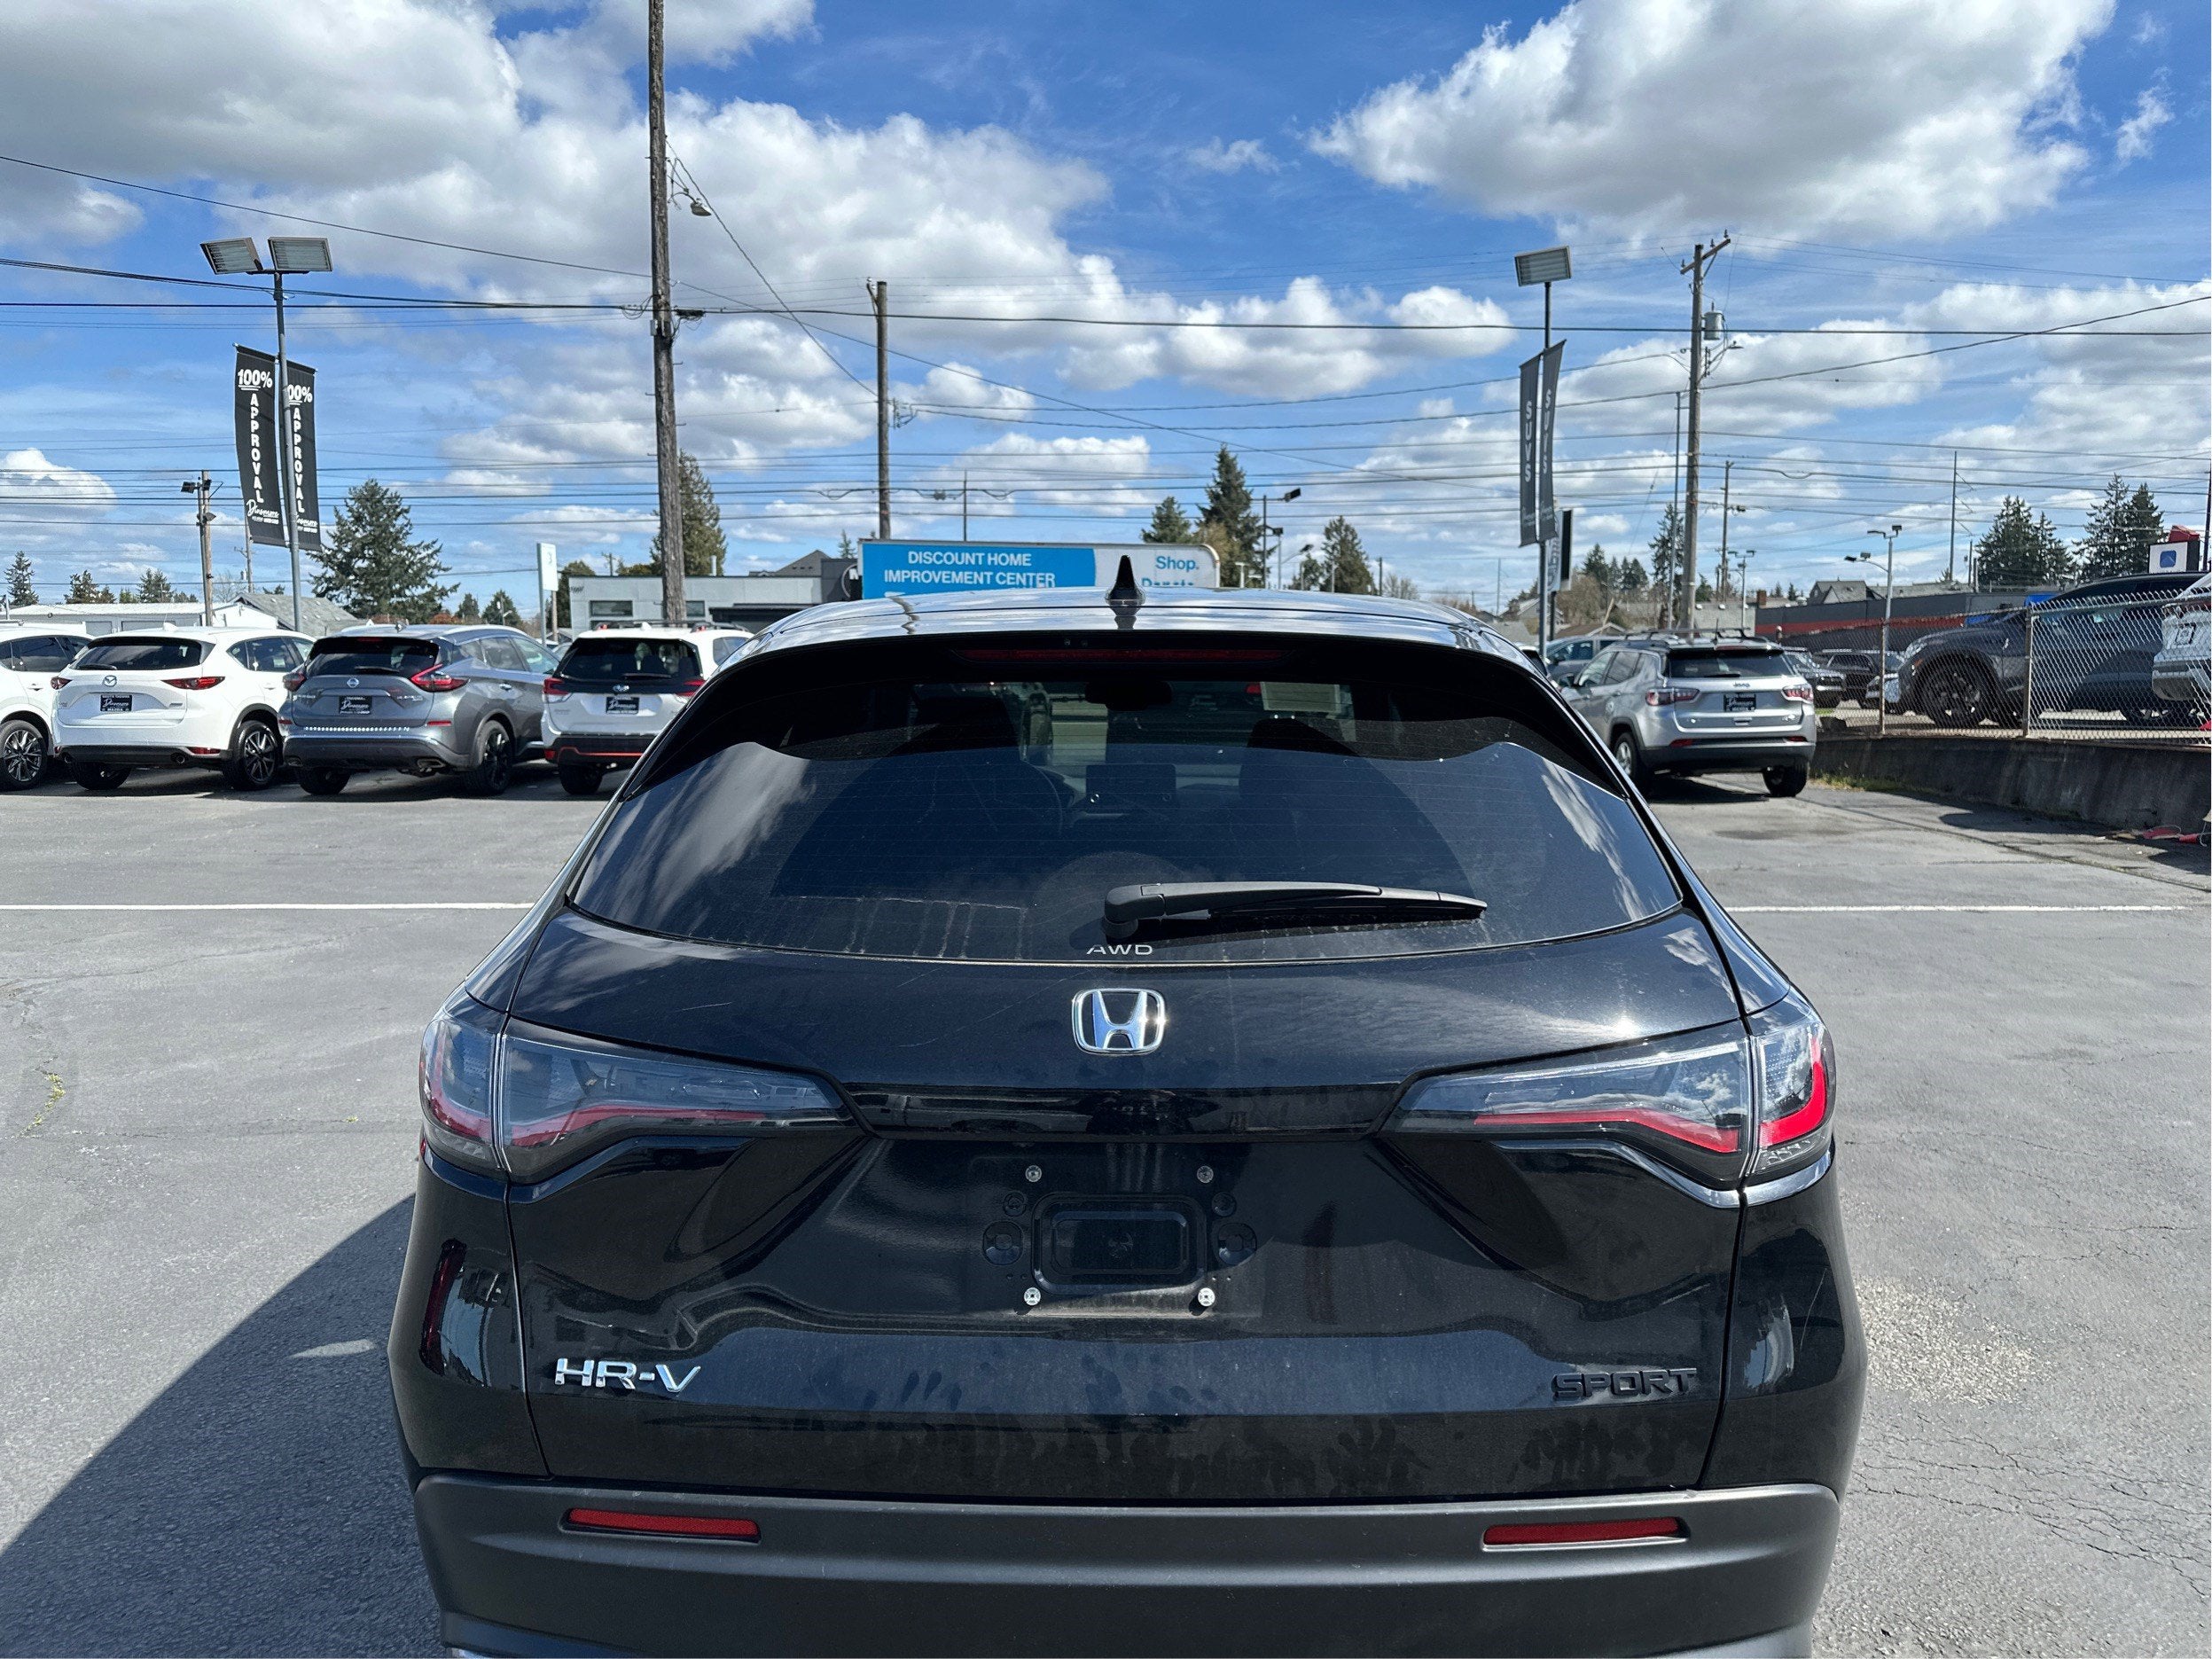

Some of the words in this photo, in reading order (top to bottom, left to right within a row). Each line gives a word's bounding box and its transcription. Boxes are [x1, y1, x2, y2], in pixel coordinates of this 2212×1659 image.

[238, 369, 273, 388] 100%
[287, 384, 313, 403] 00%
[250, 393, 264, 504] APPROVAL
[293, 407, 305, 513] APPROVAL
[908, 551, 986, 565] DISCOUNT
[988, 552, 1032, 567] HOME
[1155, 556, 1200, 573] Shop.
[884, 569, 994, 585] IMPROVEMENT
[996, 571, 1056, 588] CENTER
[1086, 944, 1153, 955] AWD
[554, 1358, 702, 1393] HR-V
[1552, 1367, 1698, 1401] SPORT
